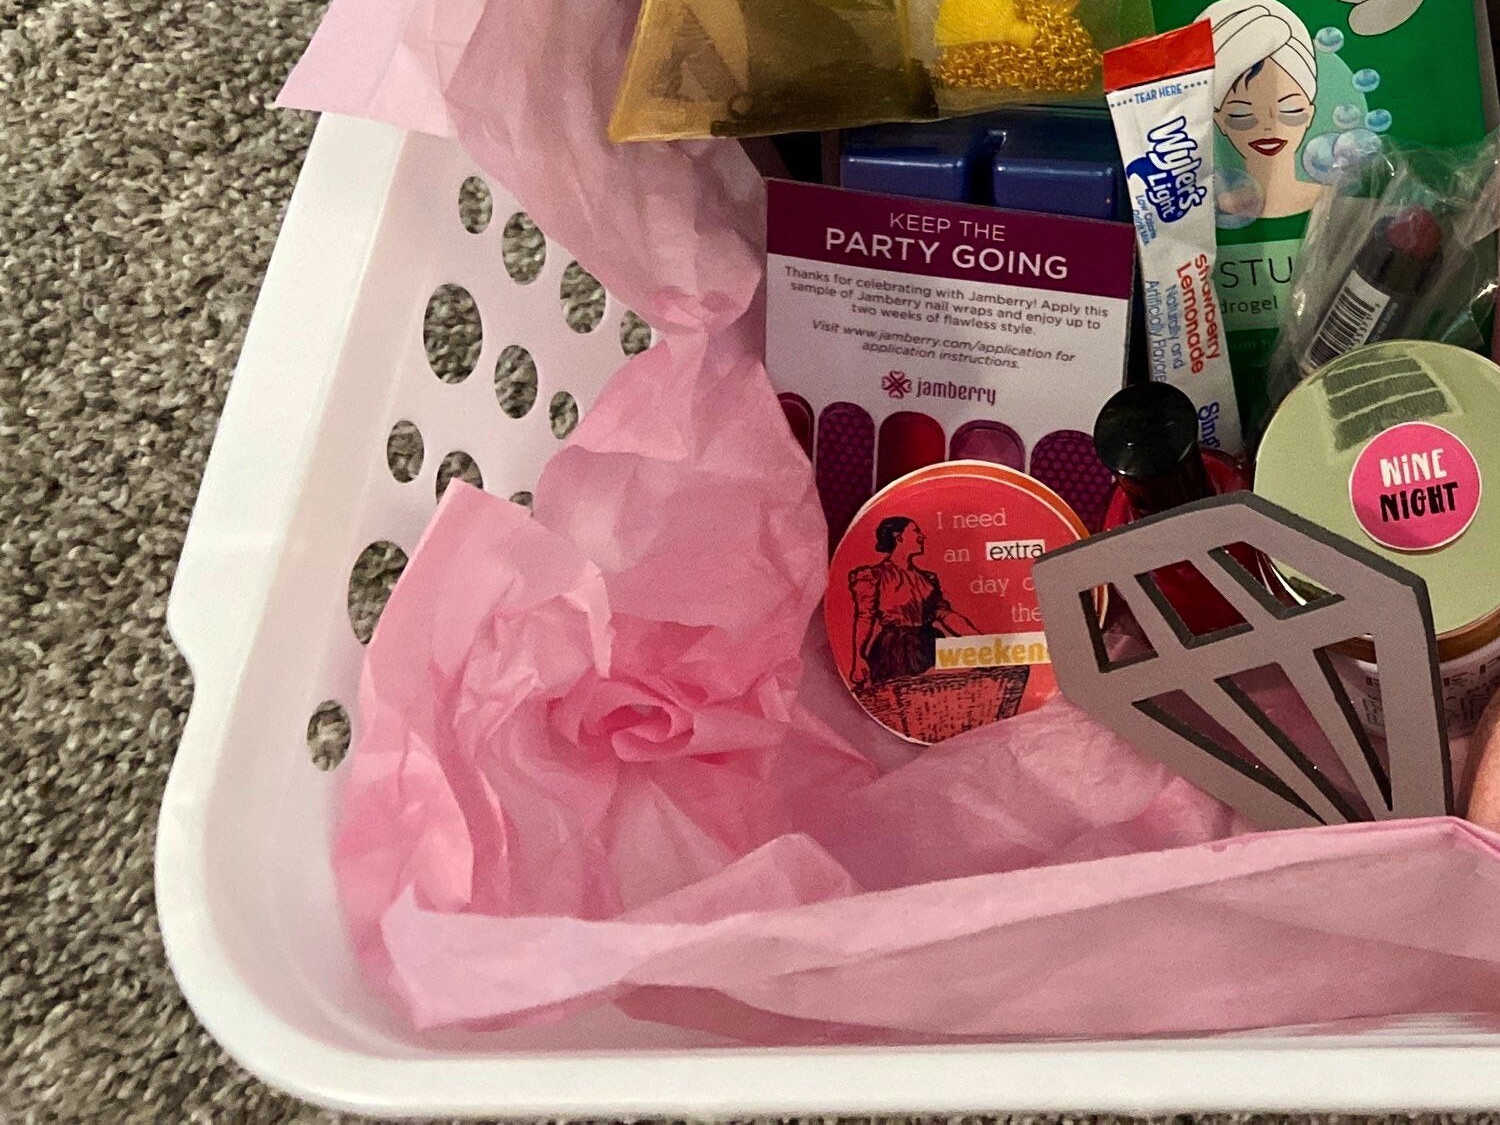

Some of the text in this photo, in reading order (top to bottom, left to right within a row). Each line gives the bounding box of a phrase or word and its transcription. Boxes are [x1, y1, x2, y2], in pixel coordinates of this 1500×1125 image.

[1134, 83, 1183, 104] TEAR HERE
[1147, 115, 1208, 211] Wyler's
[1146, 171, 1175, 219] Light
[889, 212, 1007, 242] KEEP THE
[825, 227, 1069, 281] PARTY GOING
[785, 265, 1109, 318] Thanks for celebrating with Jamberry! Apply this
[790, 281, 1101, 330] sample of Jamberry nail wraps and enjoy up to
[851, 303, 1037, 336] two weeks of flawless style.
[1165, 283, 1187, 370] Naturally and
[1176, 260, 1206, 374] Lemonade
[812, 319, 1077, 363] Visit www.jamberry.com/application for
[862, 340, 1021, 369] application instructions.
[915, 378, 997, 408] jamberry
[935, 507, 1007, 531] I need
[943, 541, 1045, 563] an extra
[969, 574, 1008, 597] day
[1010, 602, 1043, 623] the
[937, 637, 1050, 668] weeken
